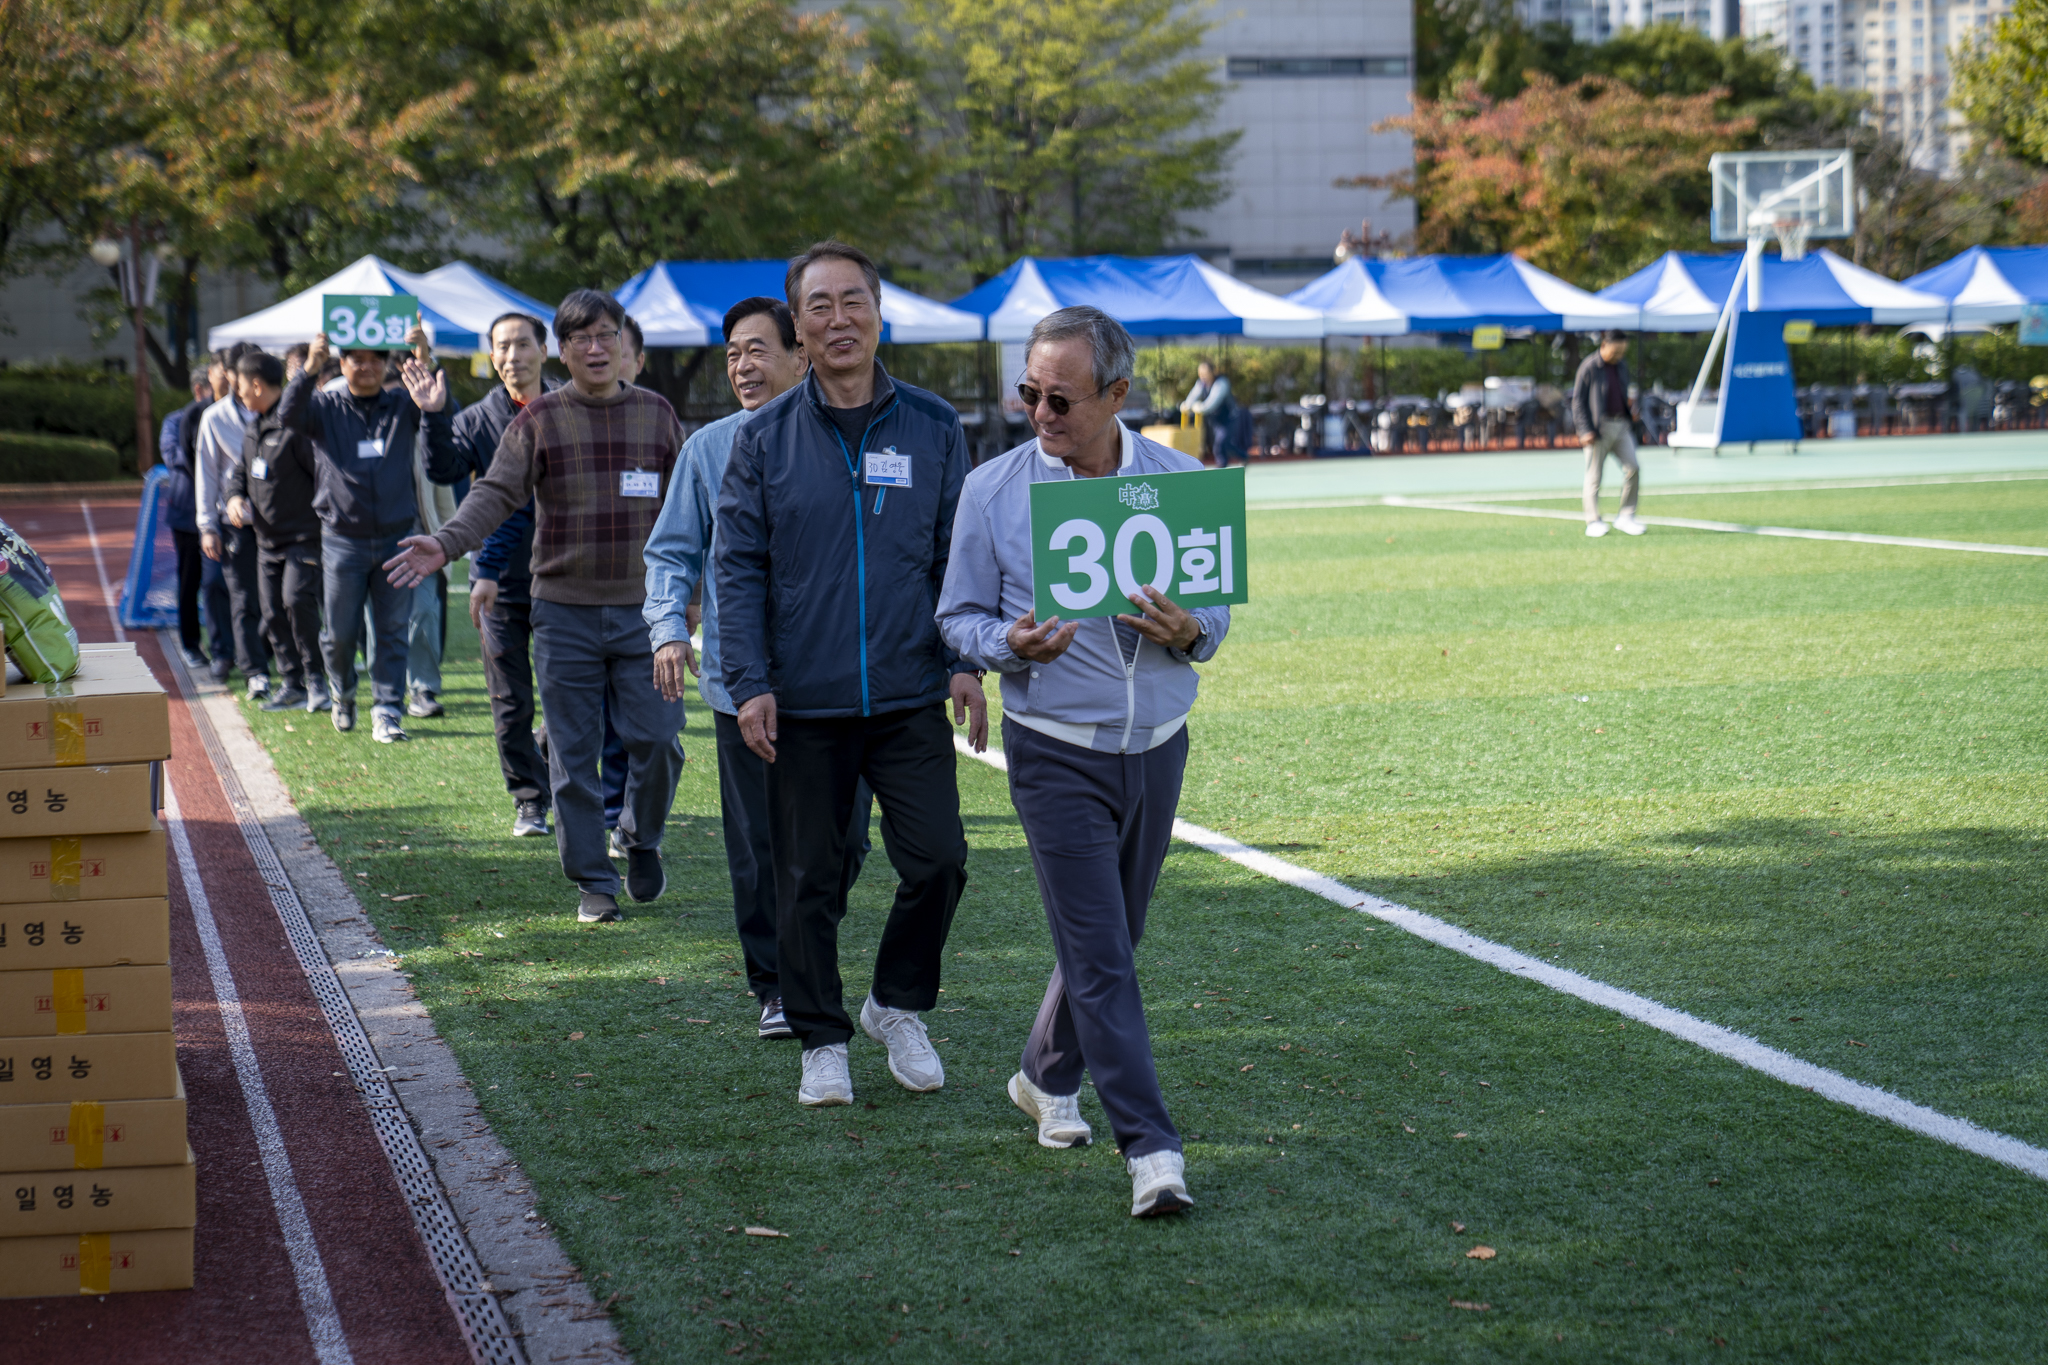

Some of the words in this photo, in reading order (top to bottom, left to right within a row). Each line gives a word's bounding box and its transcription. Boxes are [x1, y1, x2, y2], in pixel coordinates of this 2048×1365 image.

[328, 306, 411, 347] 36회
[868, 461, 878, 473] 30
[1048, 513, 1234, 610] 30회
